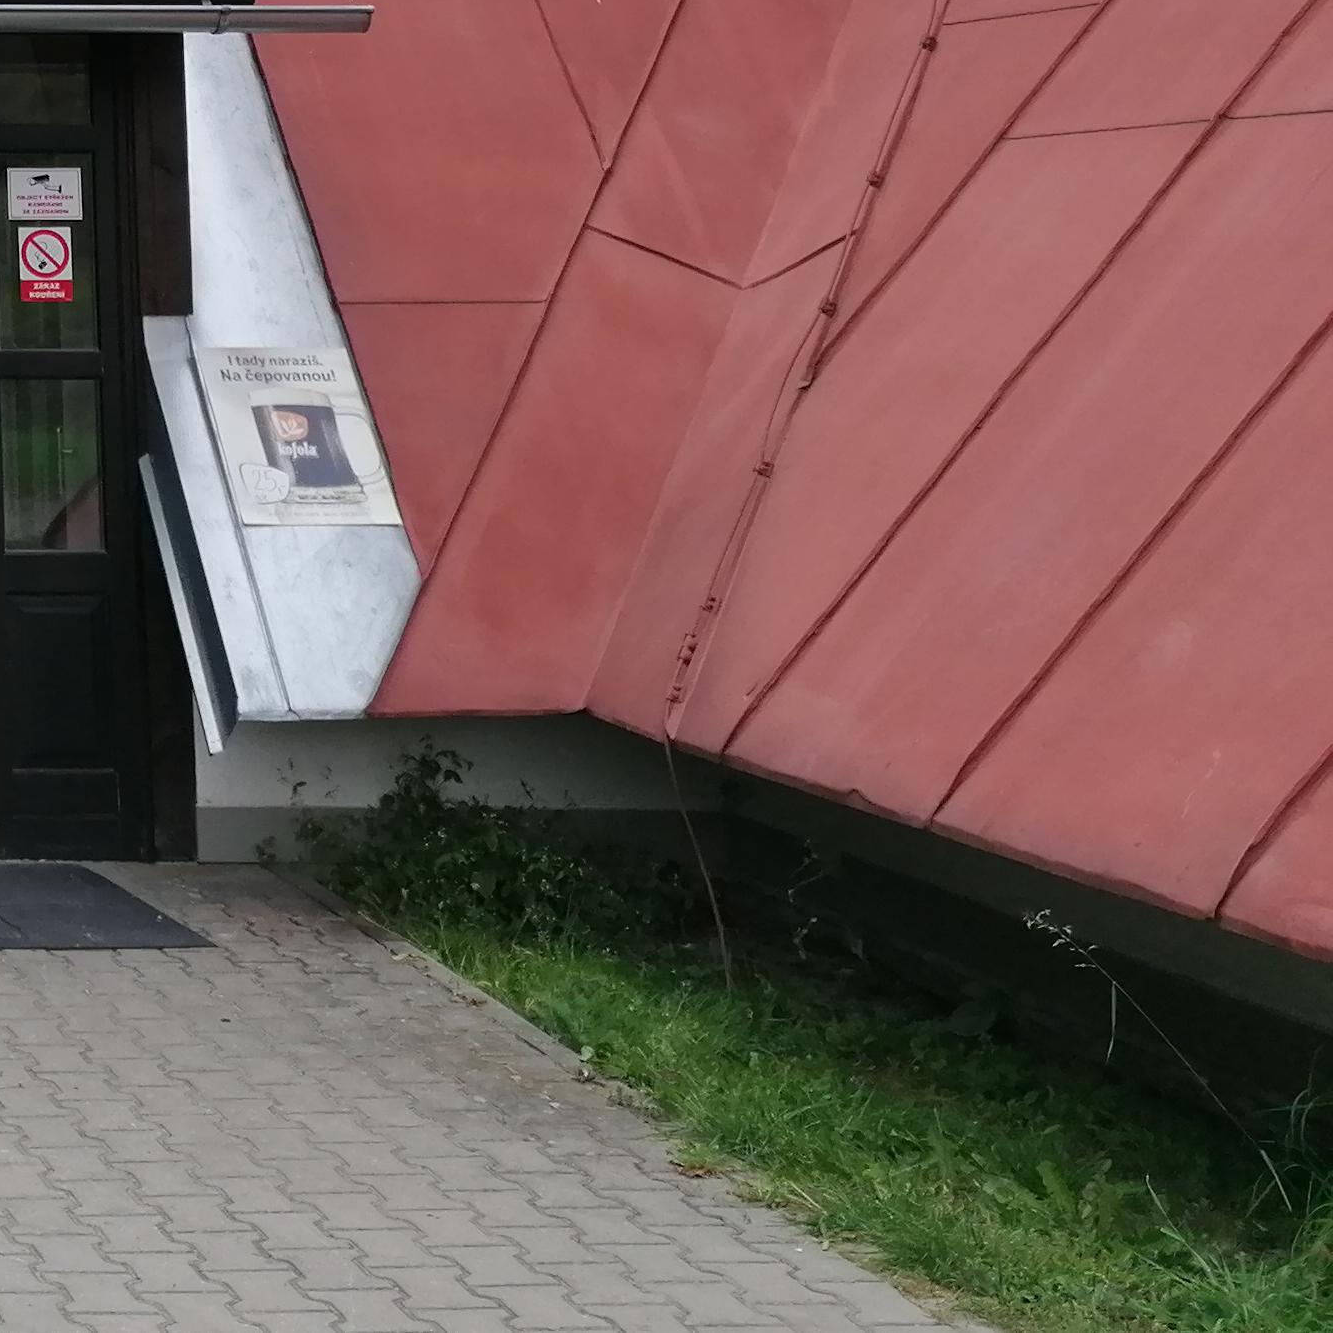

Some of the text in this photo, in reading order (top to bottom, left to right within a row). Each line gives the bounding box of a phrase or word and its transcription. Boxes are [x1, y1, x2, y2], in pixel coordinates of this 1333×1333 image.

[227, 355, 233, 366] I
[235, 355, 265, 368] tady
[220, 369, 337, 384] Na čepovanou!
